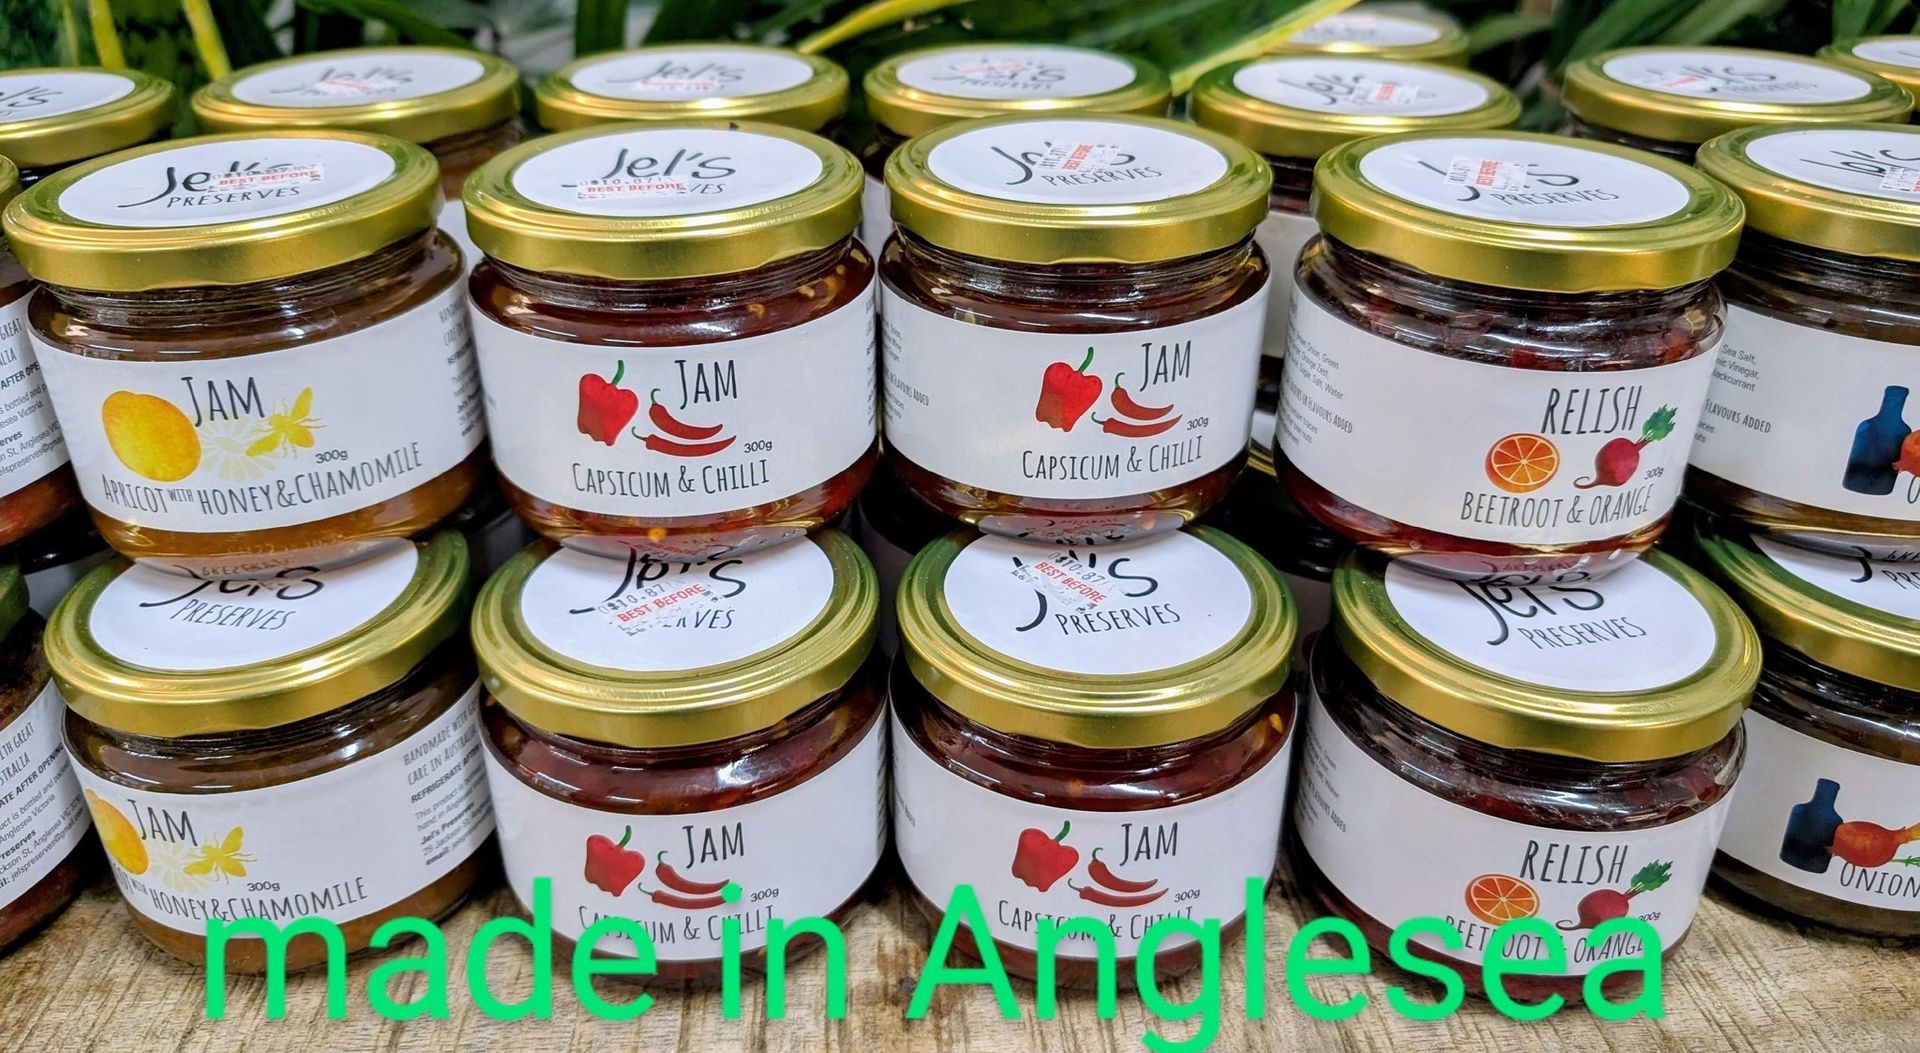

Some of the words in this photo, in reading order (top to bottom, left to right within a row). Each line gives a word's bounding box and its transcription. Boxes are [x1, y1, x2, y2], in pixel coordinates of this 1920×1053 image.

[587, 185, 623, 193] BEST
[629, 182, 685, 192] BEFORE
[1041, 166, 1163, 187] PRESERVES
[166, 186, 300, 208] PRESERVES
[1490, 188, 1620, 206] PRESERVES
[1, 318, 23, 341] GREAT
[1139, 339, 1192, 392] JAM
[1321, 352, 1340, 370] Green
[1721, 344, 1737, 358] Sea
[1, 371, 26, 390] AFTER
[674, 358, 738, 410] JAM
[1711, 367, 1756, 392] lackcurrant
[1727, 361, 1760, 381] Vinegar,
[4, 391, 30, 412] bottled
[181, 376, 266, 428] JAM
[1541, 384, 1643, 435] RELISH
[1704, 397, 1742, 425] FLAVOURS
[1741, 414, 1772, 435] ADDED
[0, 431, 23, 446] erves
[1186, 416, 1210, 432] 300g
[1332, 414, 1354, 434] ADDED
[20, 430, 51, 452] Anglesea
[315, 449, 348, 465] 300g
[743, 439, 773, 454] 300g
[1022, 450, 1120, 480] CAPSICUM
[1126, 446, 1142, 473] &
[1149, 434, 1204, 473] CHILLI
[572, 462, 671, 498] CAPSICUM
[677, 465, 696, 493] &
[702, 459, 770, 495] CHILLI
[1643, 466, 1665, 481] 300g
[102, 473, 169, 514] APRICOT
[168, 488, 195, 503] WITH
[1460, 490, 1564, 529] BEETROOT
[1566, 494, 1585, 524] &
[1588, 483, 1654, 526] ORANGE
[1034, 561, 1068, 580] BEST
[1060, 576, 1108, 604] BEFORE
[169, 598, 297, 631] PRESERVES
[617, 603, 653, 623] BEST
[652, 583, 707, 610] BEFORE
[1055, 602, 1181, 636] PRESERVES
[1517, 616, 1648, 650] PRESERVES
[1, 740, 14, 761] ITH
[13, 721, 35, 749] GREAT
[402, 725, 451, 767] HANDMADE
[15, 770, 39, 797] AFTER
[37, 741, 65, 775] OPENING
[407, 763, 430, 786] CARE
[429, 753, 442, 772] IN
[410, 760, 464, 804] REFRIGERATE
[12, 811, 20, 821] is
[19, 789, 43, 815] bottled
[127, 798, 199, 847] JAM
[420, 829, 441, 846] Jel's
[0, 829, 37, 861] reserves
[0, 855, 22, 876] ckson
[33, 817, 62, 850] Anglesea
[682, 821, 745, 869] JAM
[1119, 821, 1179, 867] JAM
[1519, 839, 1629, 886] RELISH
[247, 880, 281, 893] 300g
[750, 886, 780, 903] 300g
[1839, 861, 1920, 898] ONION
[1174, 889, 1201, 903] 300g
[683, 915, 701, 940] &
